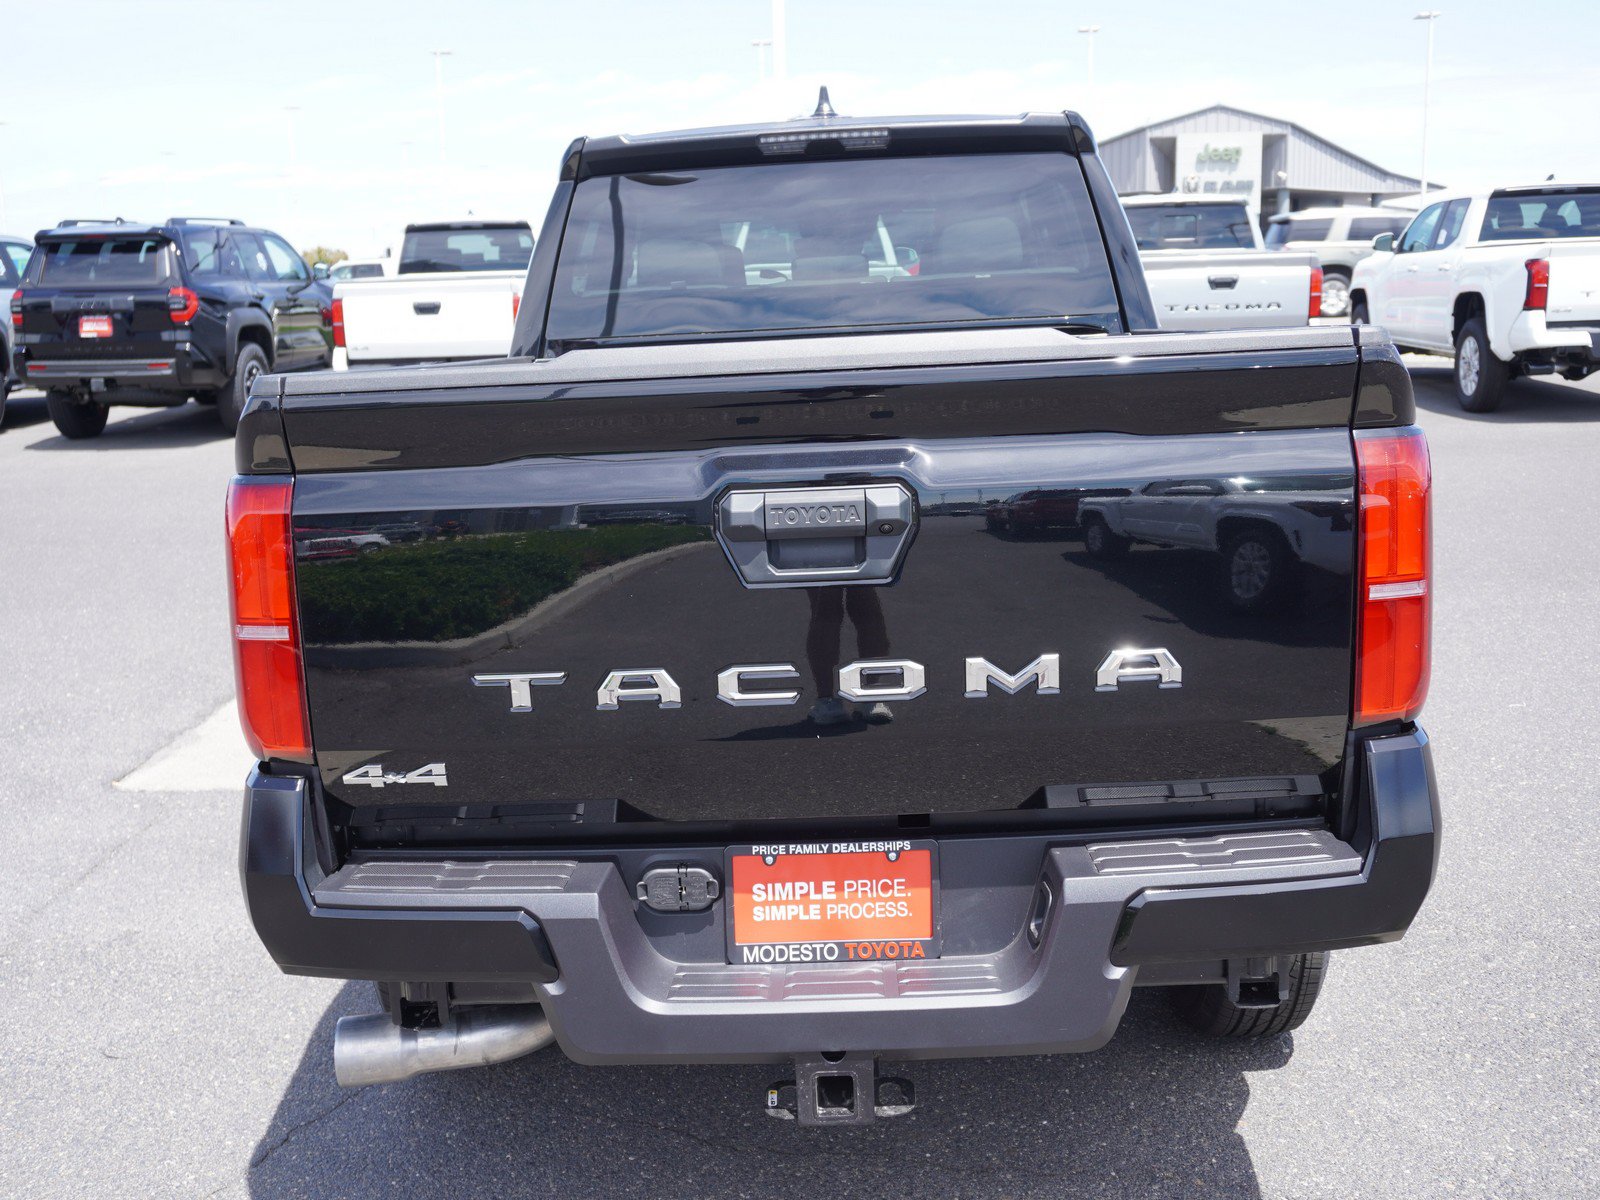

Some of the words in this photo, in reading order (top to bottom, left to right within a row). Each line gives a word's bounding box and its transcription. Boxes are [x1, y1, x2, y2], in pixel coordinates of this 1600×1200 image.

[1196, 144, 1242, 164] Jeep
[1163, 301, 1281, 311] TACOMA
[770, 504, 861, 525] TOYOTA
[470, 648, 1183, 713] TACOMA
[752, 845, 786, 855] PRICE
[789, 843, 829, 854] FAMILY
[832, 841, 911, 853] DEALERSHIPS
[752, 881, 837, 902] SIMPLE
[843, 878, 912, 899] PRICE.
[752, 904, 822, 921] SIMPLE
[826, 901, 913, 920] PROCESS.
[743, 943, 839, 963] MODESTO
[845, 941, 925, 959] TOYOTA
